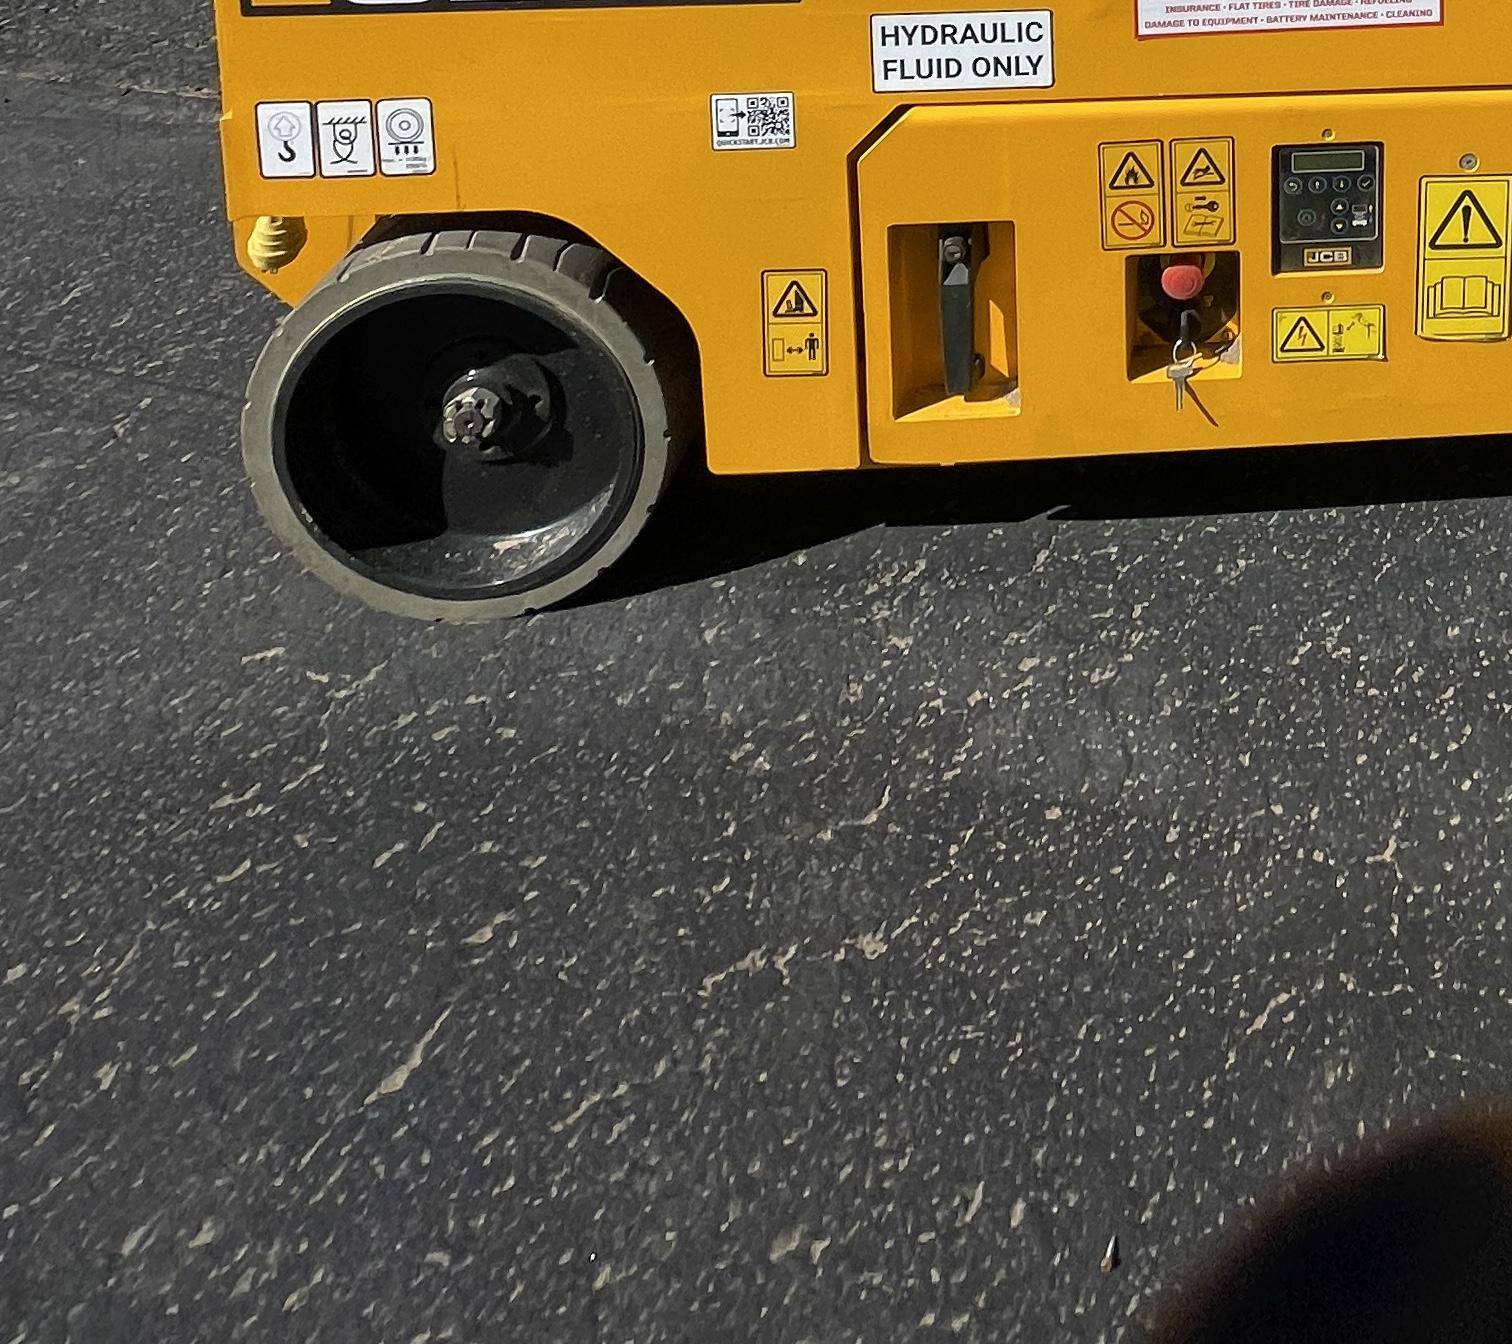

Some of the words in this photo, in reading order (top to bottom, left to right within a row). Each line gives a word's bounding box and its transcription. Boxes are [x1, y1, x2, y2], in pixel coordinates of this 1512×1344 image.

[1166, 3, 1221, 14] INSURANCE
[1228, 2, 1250, 11] FLAT
[1252, 1, 1282, 10] TIRES
[1289, 0, 1310, 8] TIRE
[1144, 19, 1185, 29] DAMAGE
[1187, 18, 1199, 27] TO
[1202, 16, 1258, 26] EQUIPMENT
[1266, 14, 1307, 24] BATTERY
[1310, 11, 1378, 22] MAINTENANCE
[1386, 9, 1433, 18] CLEANING
[880, 21, 1044, 47] HYDRAULIC
[882, 57, 963, 81] FLUID
[971, 54, 1044, 78] ONLY
[1307, 251, 1348, 263] JCB
